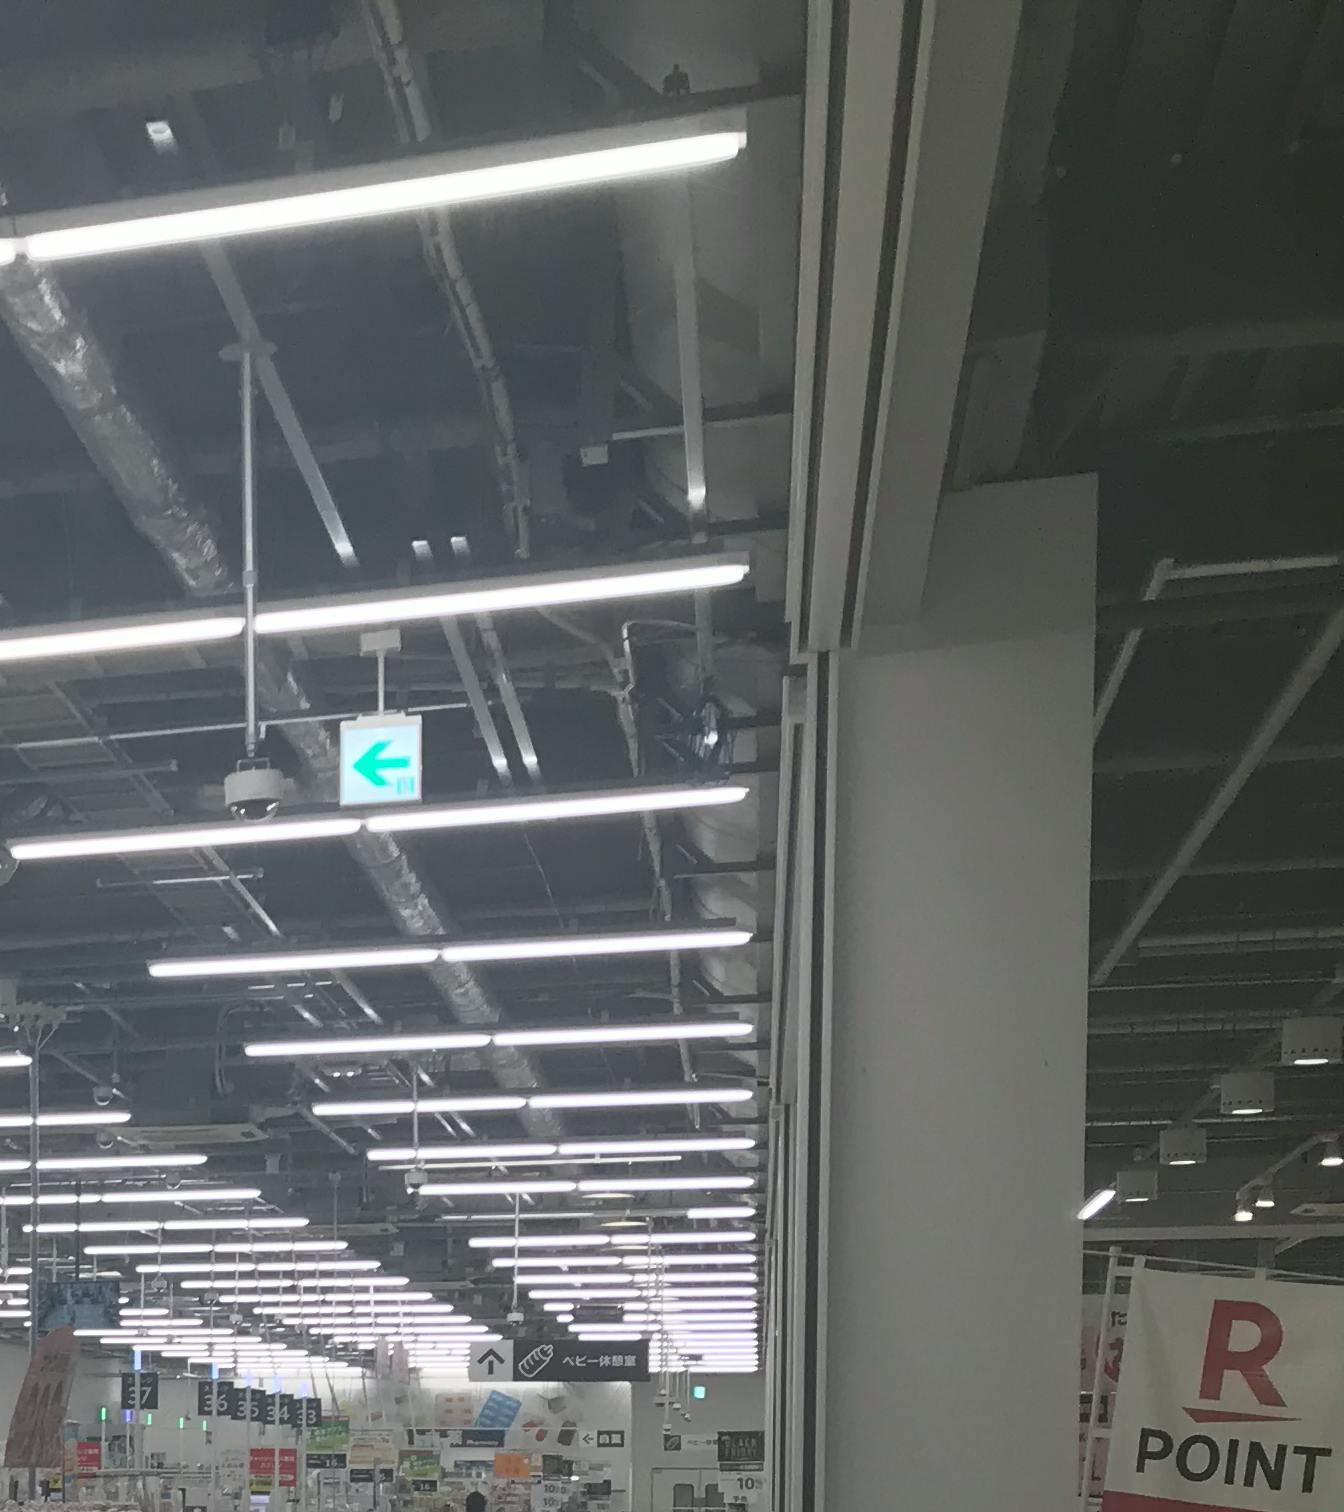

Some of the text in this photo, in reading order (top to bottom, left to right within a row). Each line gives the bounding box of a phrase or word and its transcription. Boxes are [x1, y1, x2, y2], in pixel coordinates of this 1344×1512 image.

[562, 1354, 637, 1368] ベビー休憩室
[1199, 1299, 1288, 1408] R
[127, 1387, 152, 1404] 37
[204, 1394, 228, 1412] 36
[237, 1401, 259, 1417] 35
[266, 1406, 290, 1421] 34
[296, 1410, 317, 1425] 33
[1136, 1427, 1332, 1494] POINT
